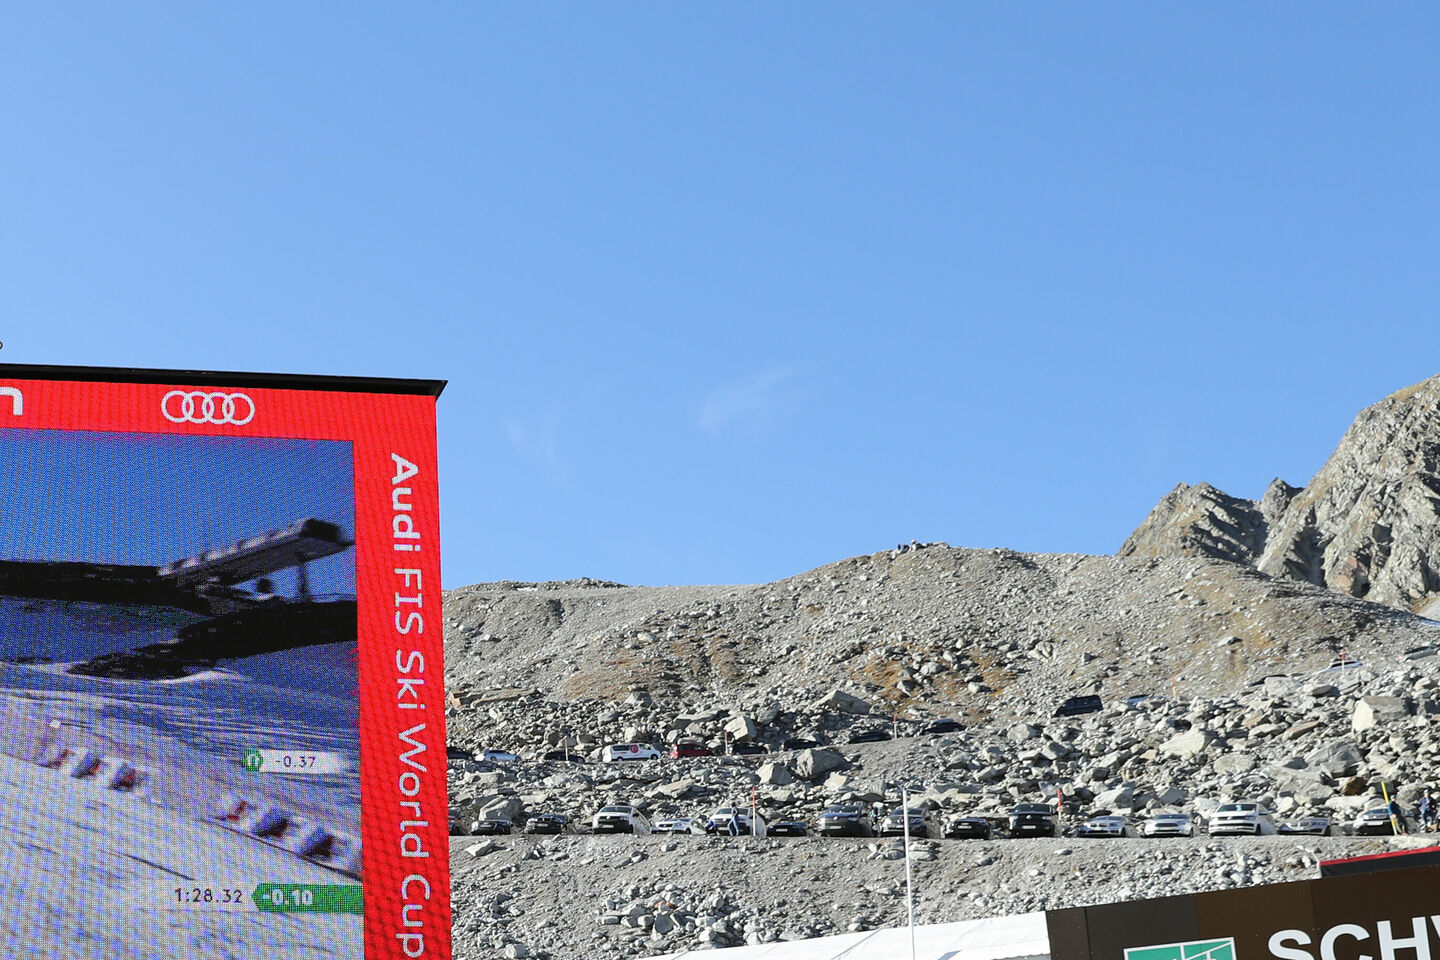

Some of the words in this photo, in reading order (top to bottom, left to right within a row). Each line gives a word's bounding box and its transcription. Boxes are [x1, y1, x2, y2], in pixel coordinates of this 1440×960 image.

[390, 452, 421, 552] Audi
[394, 567, 424, 635] FIS
[395, 649, 426, 709] Ski
[275, 755, 316, 768] -0.37
[398, 723, 430, 858] World
[175, 888, 243, 903] 1:28.32
[262, 888, 314, 906] -0.10
[395, 874, 431, 958] Cup
